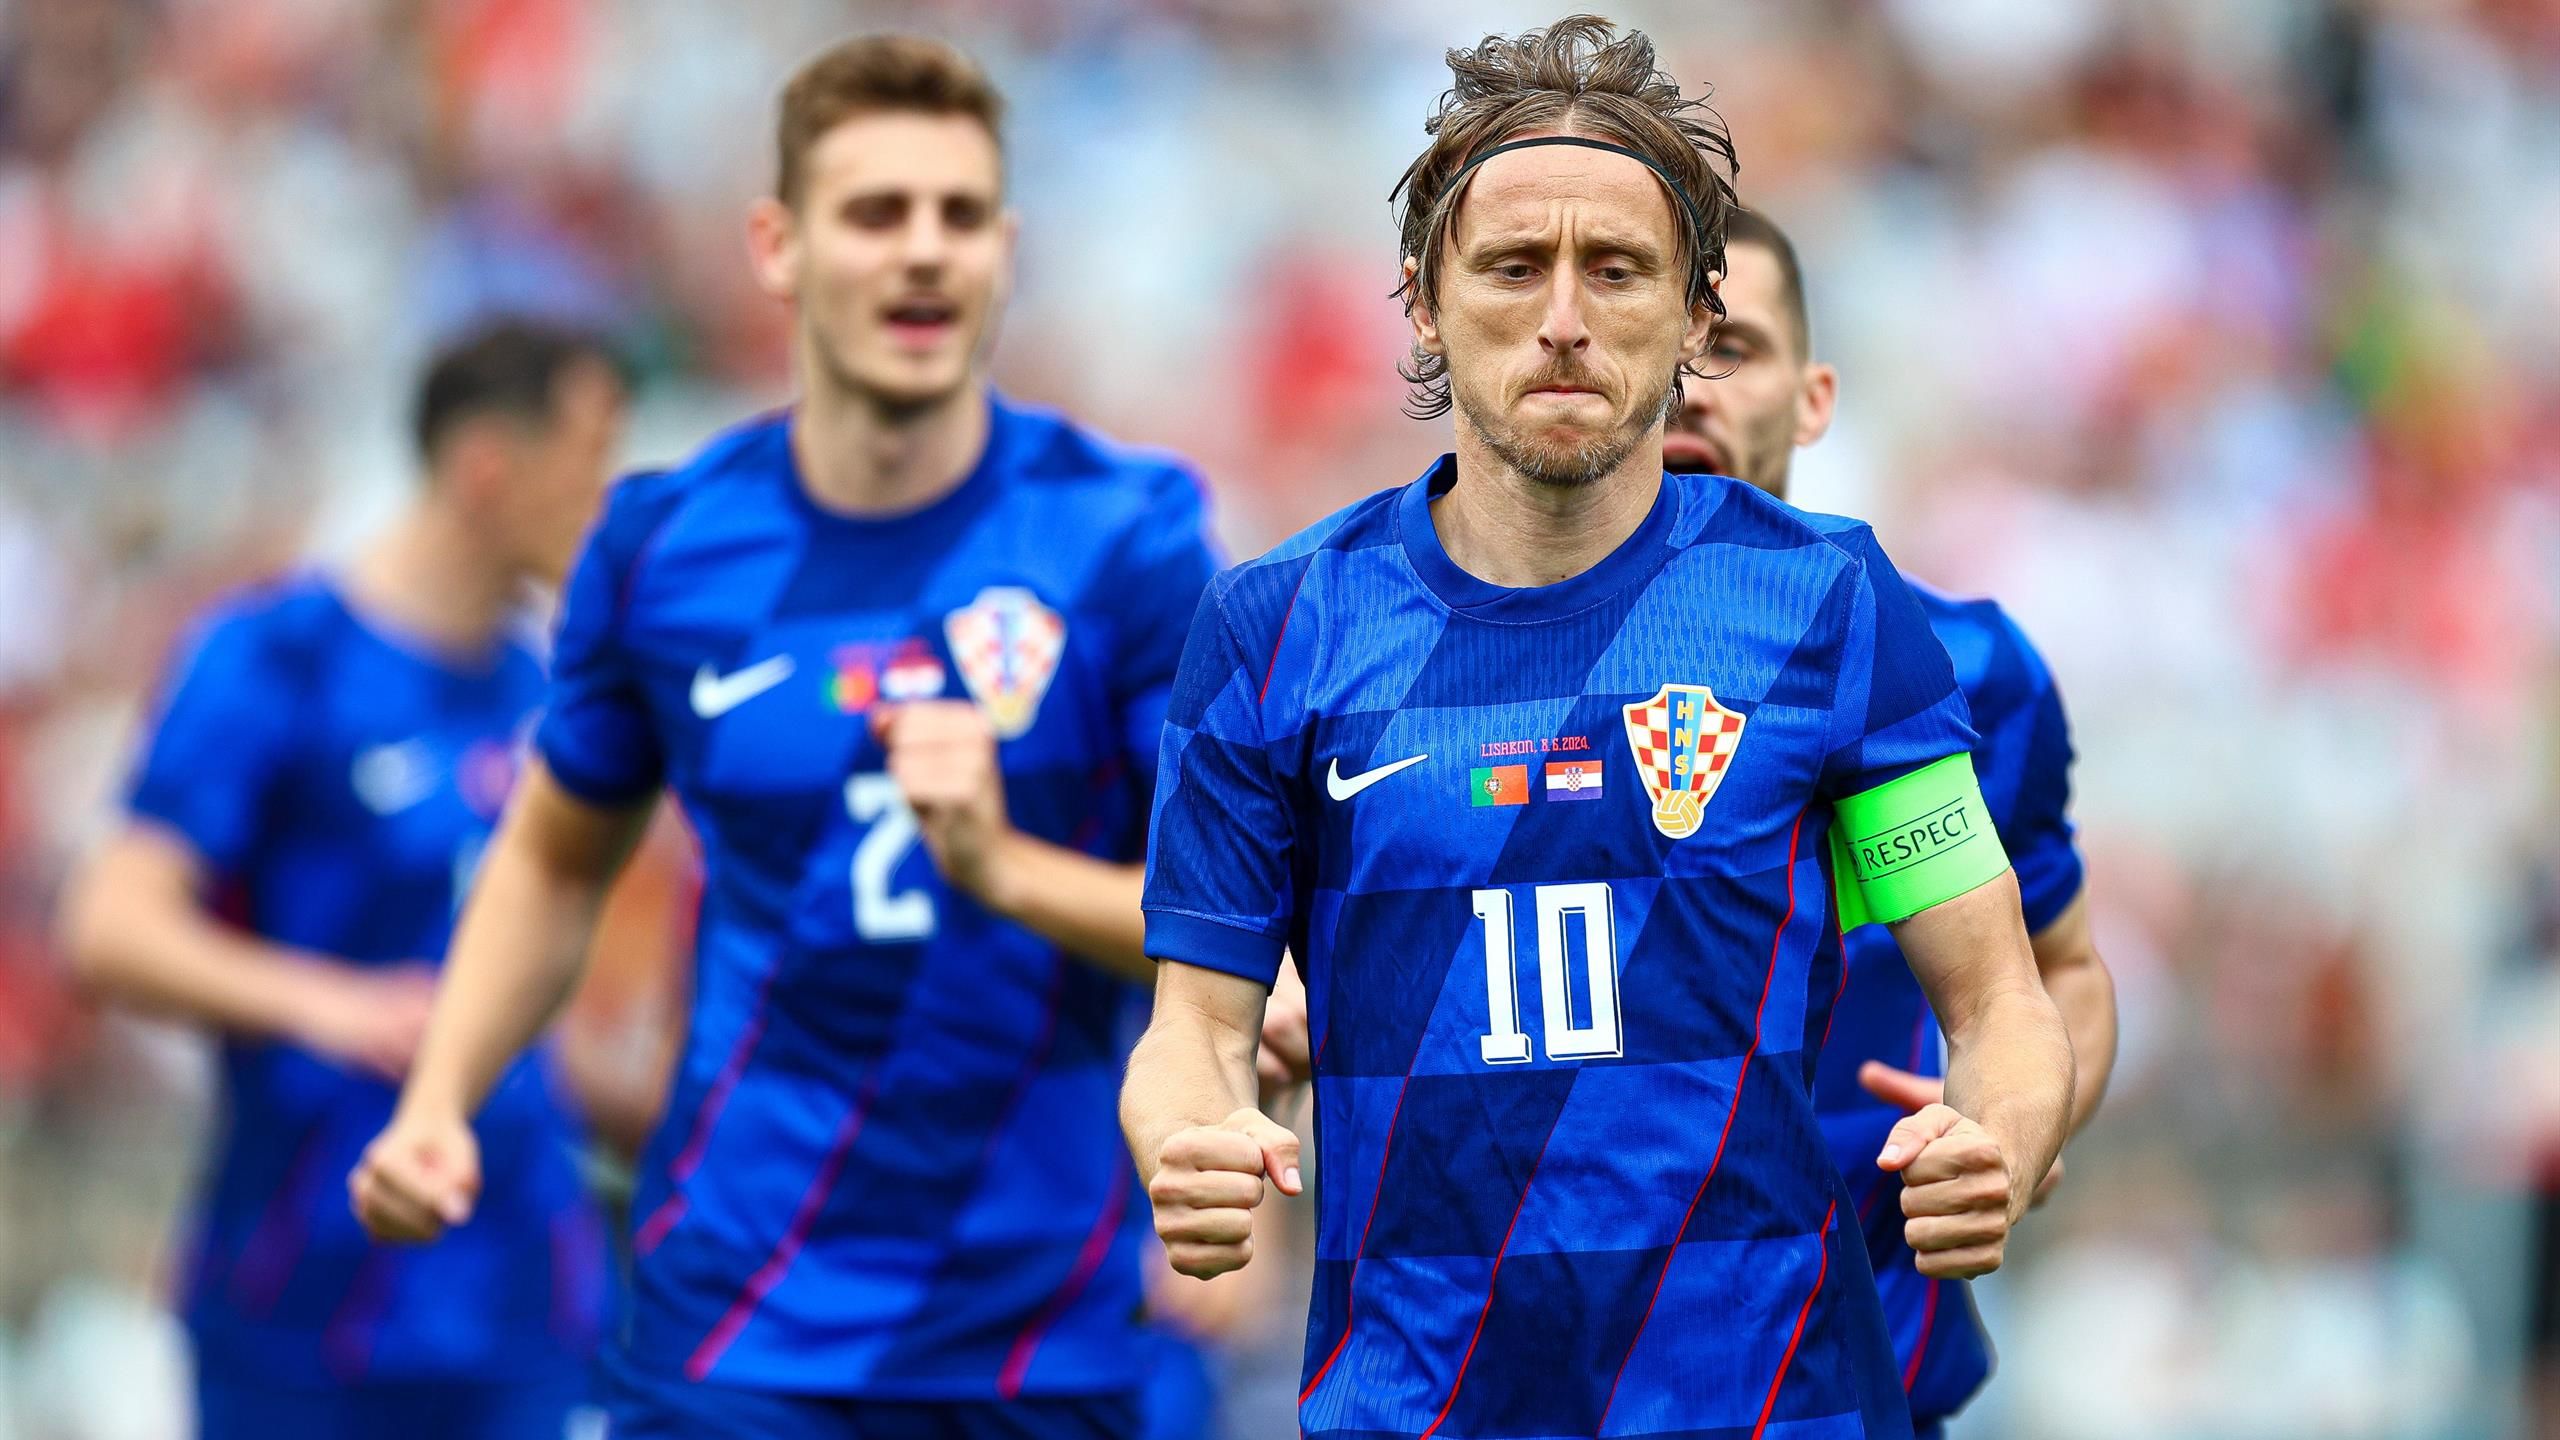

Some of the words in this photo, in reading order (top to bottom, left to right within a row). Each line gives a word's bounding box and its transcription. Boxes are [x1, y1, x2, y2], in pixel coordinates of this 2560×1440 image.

[1675, 701, 1695, 776] HNS
[844, 772, 936, 943] 2
[1863, 807, 1969, 871] RESPECT
[1472, 882, 1624, 1065] 10
